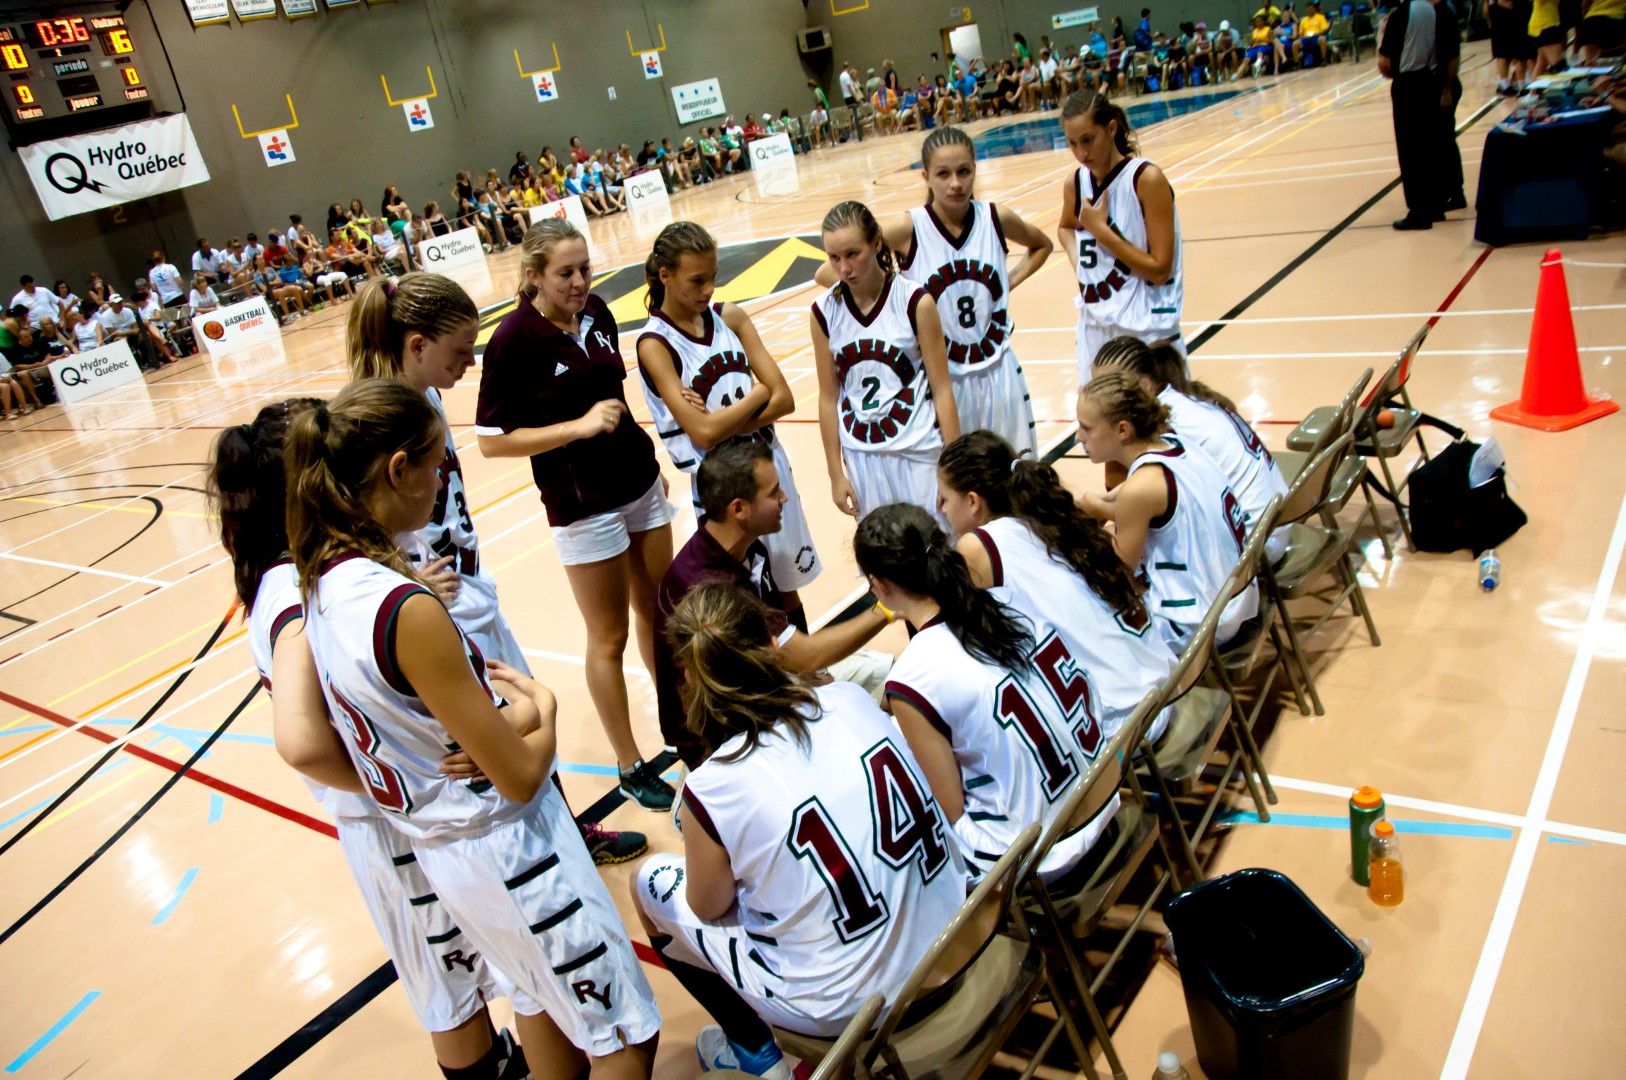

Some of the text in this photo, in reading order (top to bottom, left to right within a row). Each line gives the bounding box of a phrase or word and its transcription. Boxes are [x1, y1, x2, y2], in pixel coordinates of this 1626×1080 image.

[109, 30, 134, 54] 16
[1, 44, 29, 69] 10
[69, 96, 99, 111] joueur
[681, 96, 718, 111] WEBDIFFUSEUR
[691, 108, 713, 119] OFFICIEL
[88, 141, 147, 166] Hydro
[118, 153, 187, 180] Québec
[441, 240, 462, 250] Hydro
[1080, 238, 1098, 269] 5
[224, 306, 267, 328] BASKETBALL
[957, 295, 977, 329] 8
[593, 330, 616, 354] RY
[80, 357, 109, 372] Hydro
[94, 360, 129, 377] Québec
[861, 376, 881, 411] 2
[993, 628, 1105, 804] 15
[786, 736, 950, 945] 14
[441, 949, 478, 973] RY
[571, 979, 612, 1011] RY
